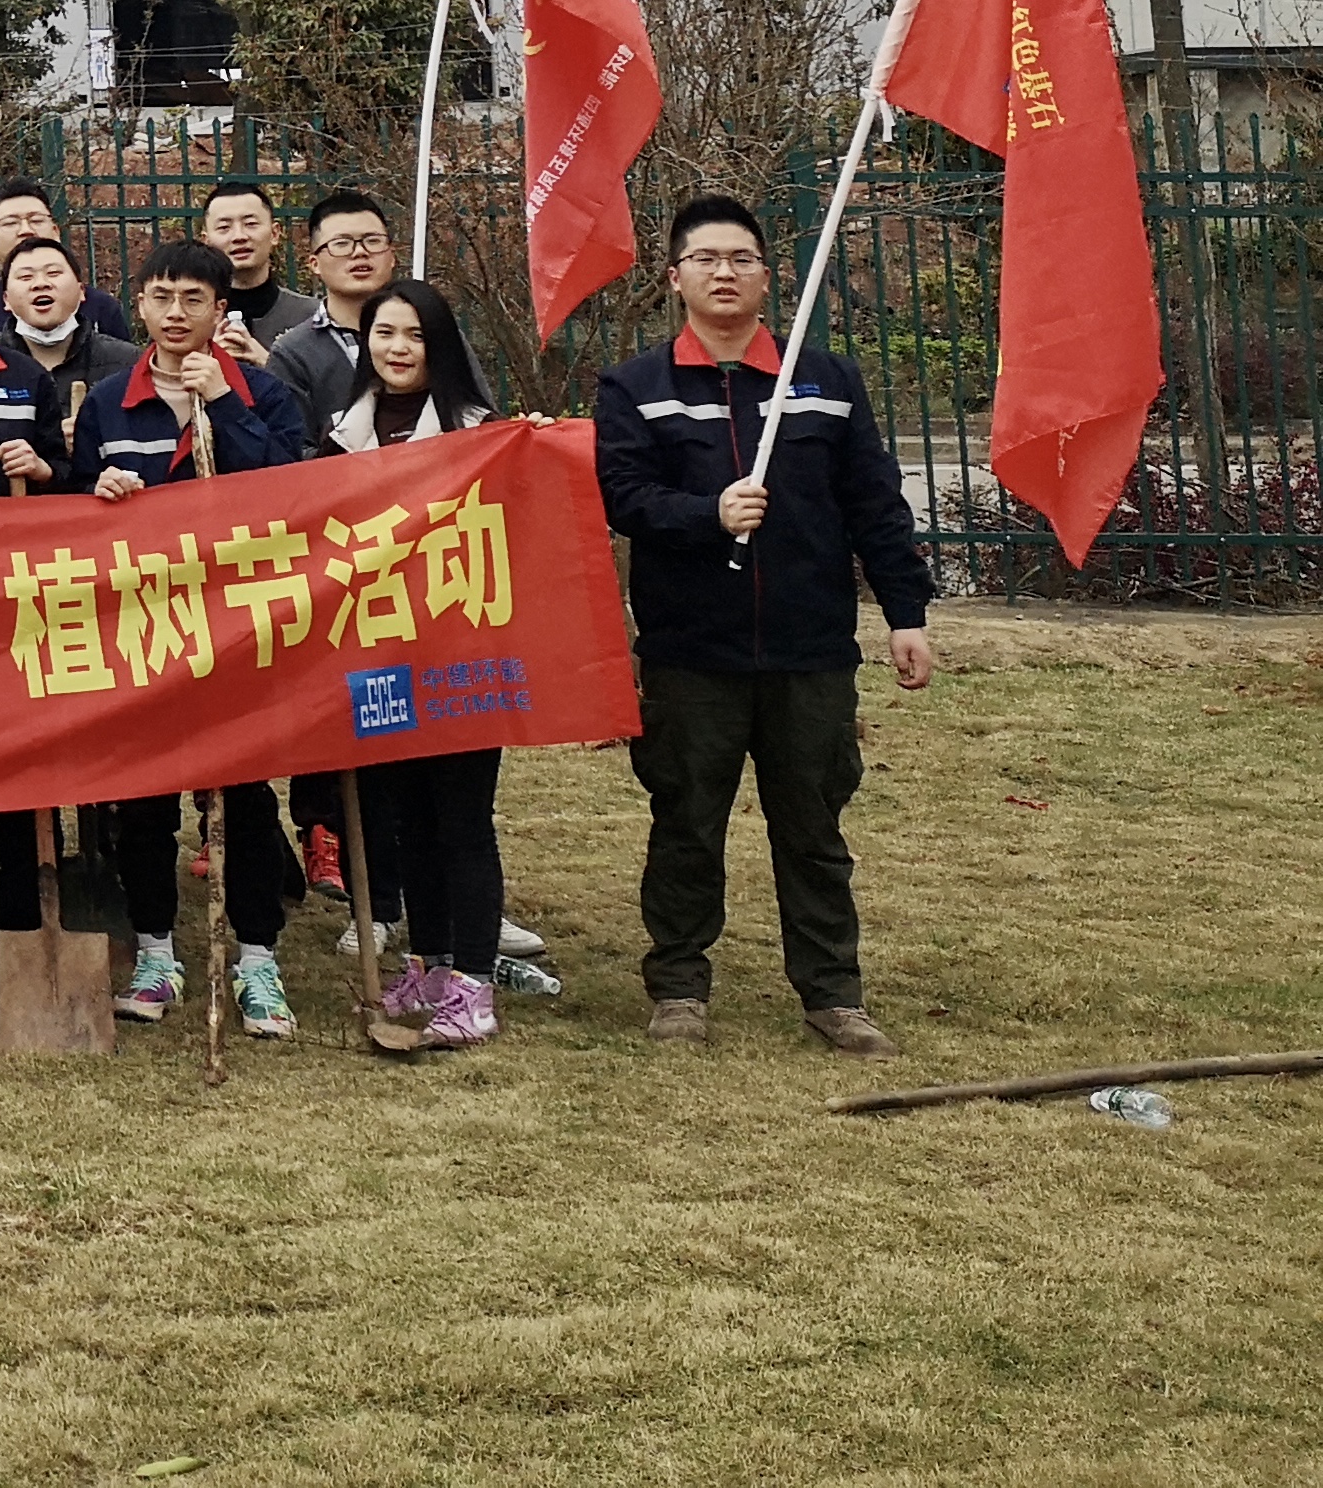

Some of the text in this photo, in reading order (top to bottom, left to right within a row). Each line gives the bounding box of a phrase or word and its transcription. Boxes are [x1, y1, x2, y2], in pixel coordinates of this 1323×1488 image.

[3, 478, 514, 700] 植树节活动
[421, 657, 527, 692] 中建环能
[425, 690, 533, 720] SCIMEE
